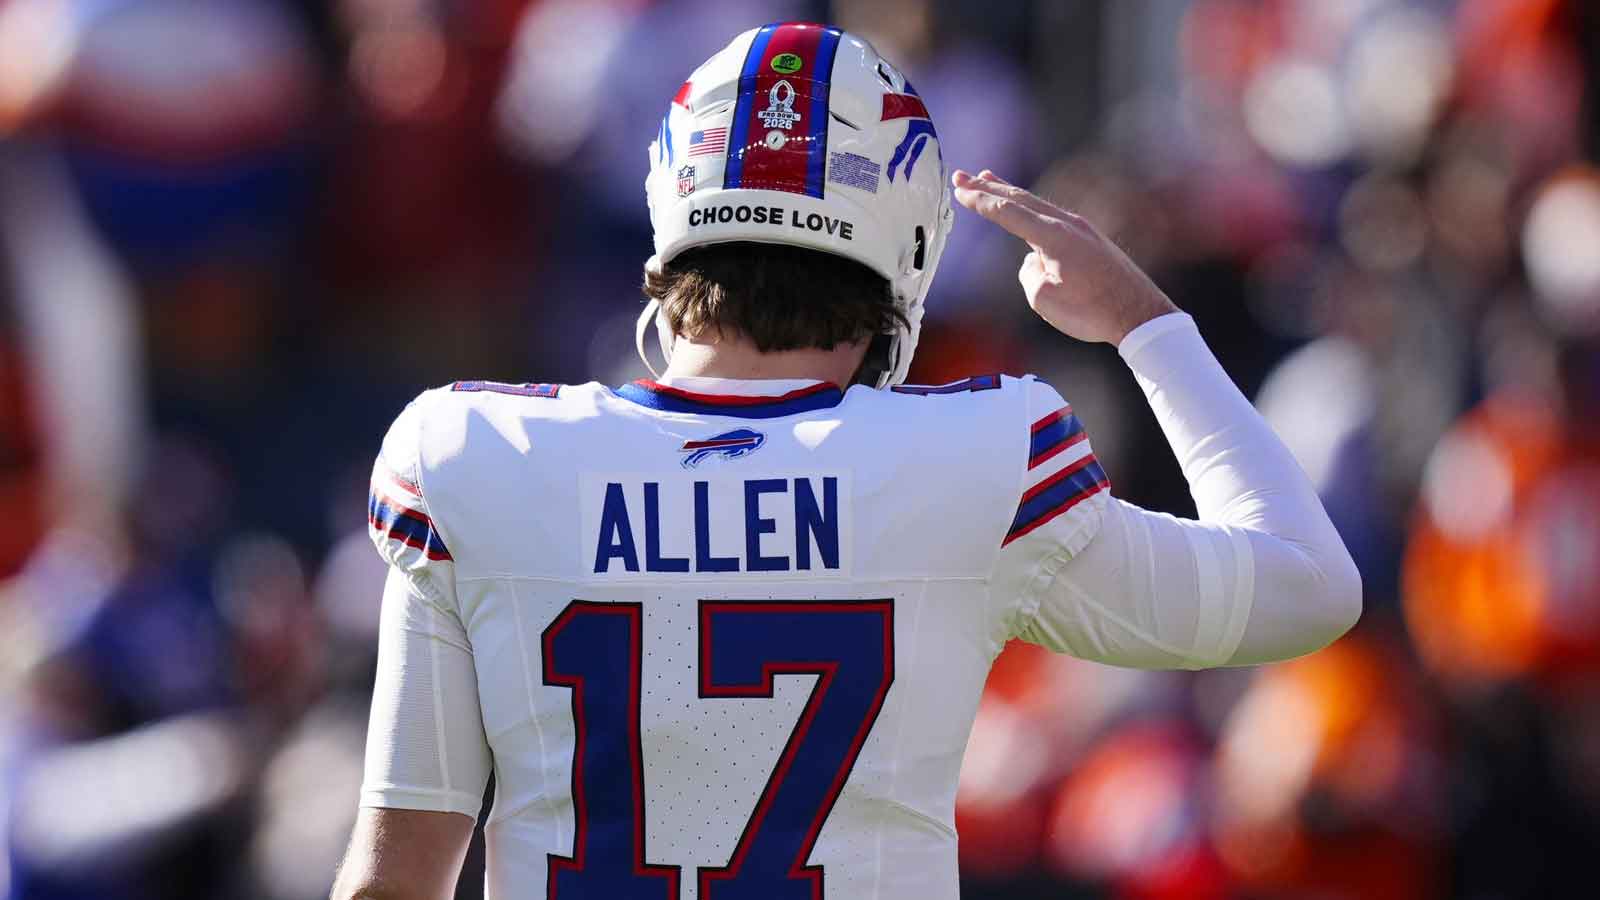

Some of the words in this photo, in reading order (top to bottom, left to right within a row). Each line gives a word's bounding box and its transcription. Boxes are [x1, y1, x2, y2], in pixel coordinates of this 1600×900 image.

[763, 118, 793, 130] 2026
[776, 112, 797, 120] BOWL
[689, 205, 784, 226] CHOOSE
[792, 210, 853, 240] LOVE
[593, 476, 840, 573] ALLEN
[541, 598, 895, 900] 17
